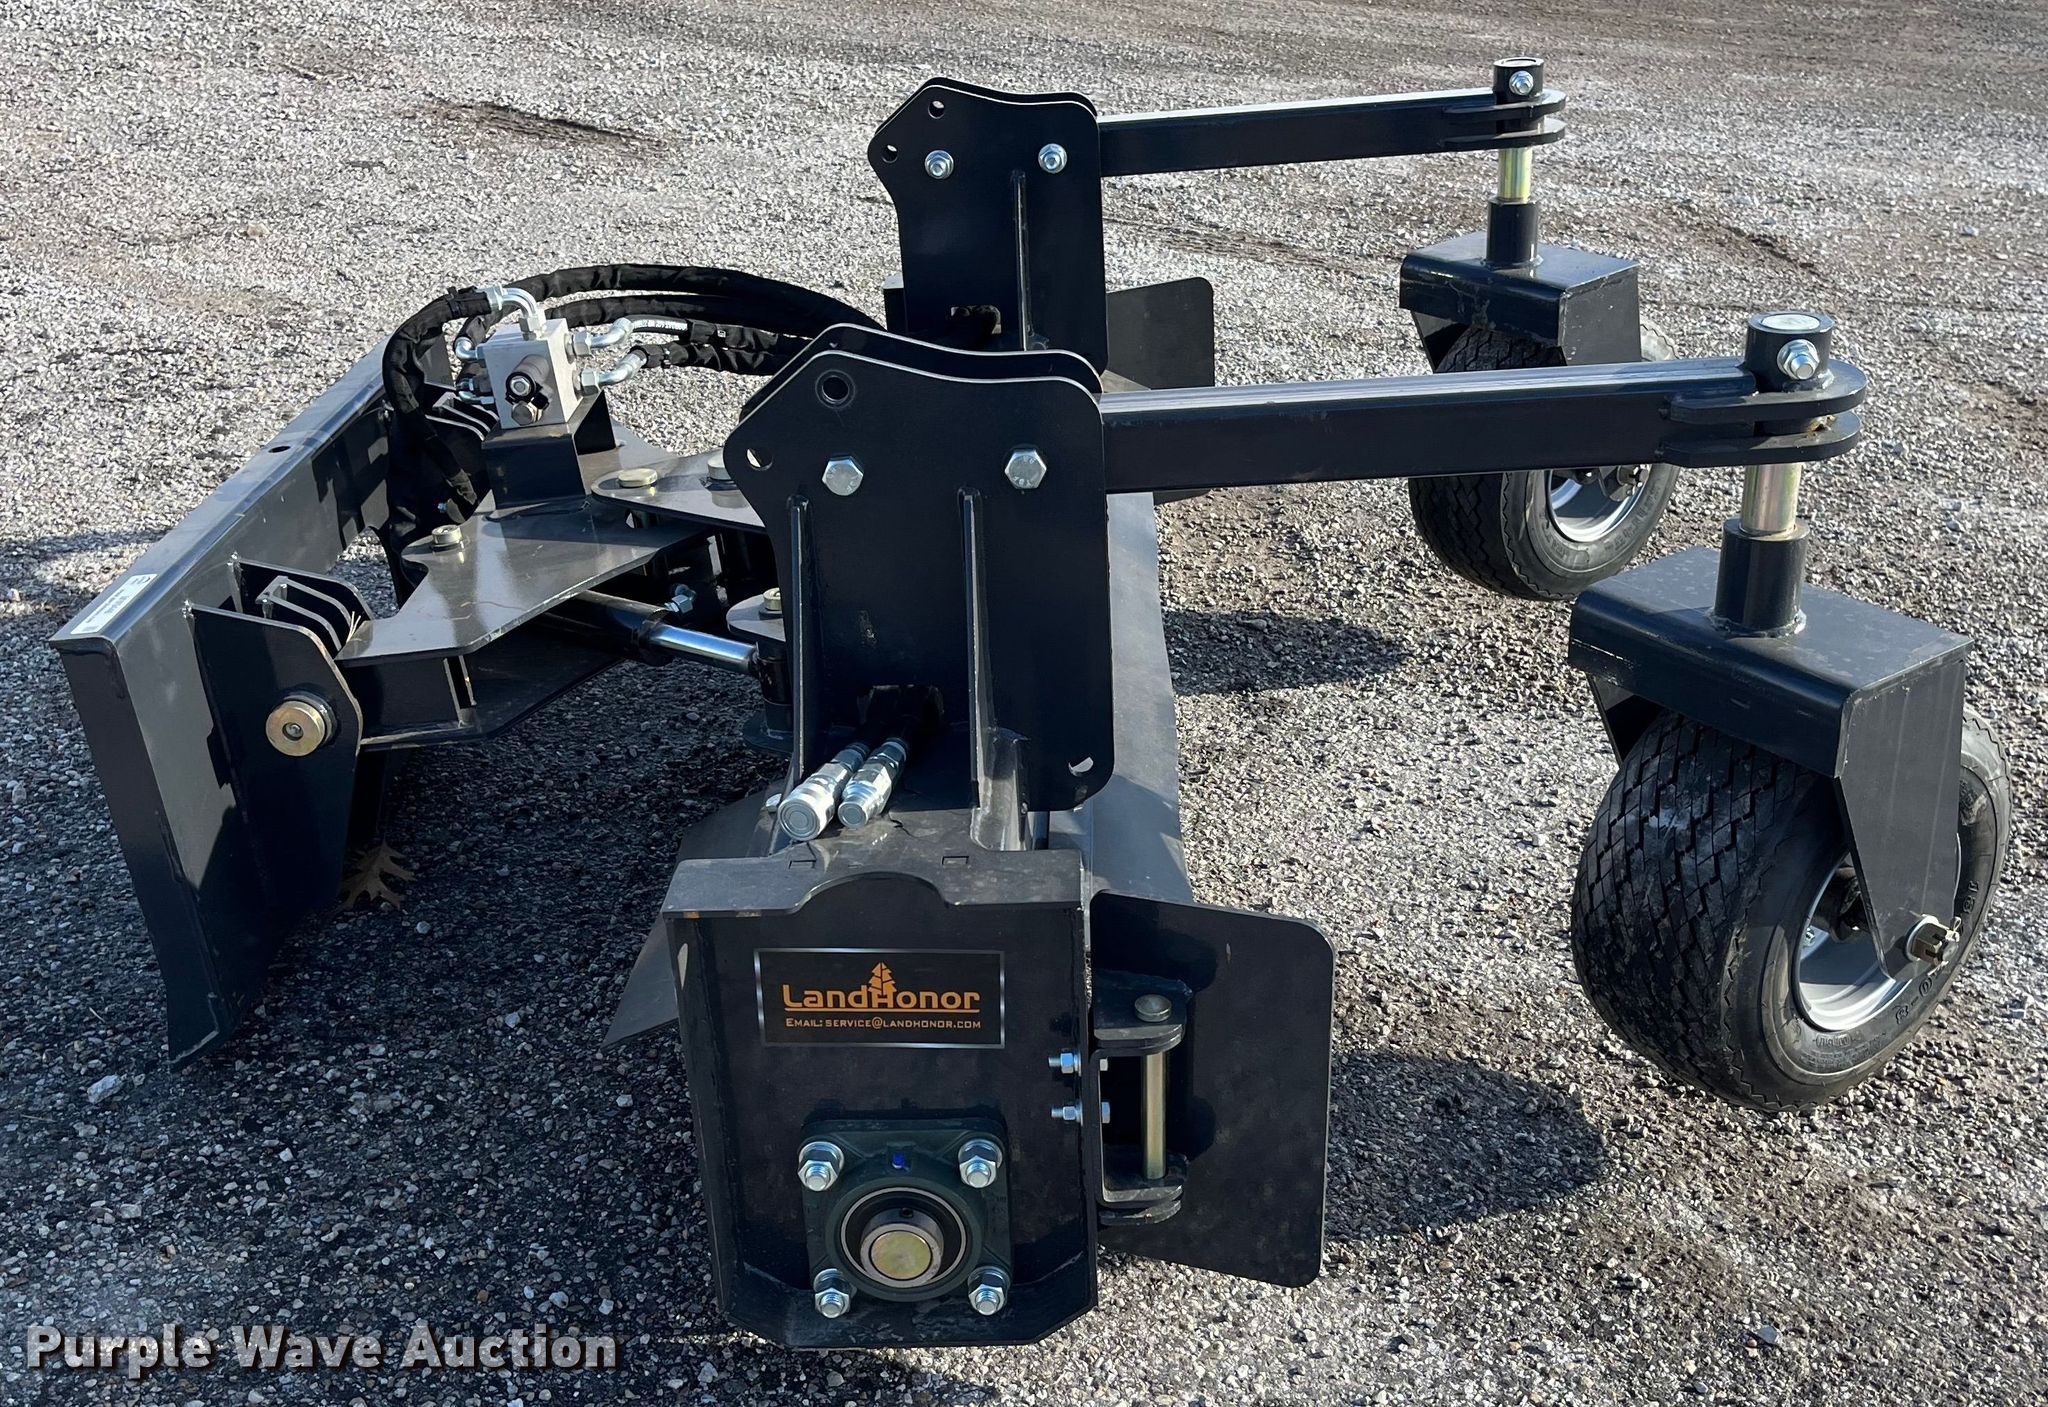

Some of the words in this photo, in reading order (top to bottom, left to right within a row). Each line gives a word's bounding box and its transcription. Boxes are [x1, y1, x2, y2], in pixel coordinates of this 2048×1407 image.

[782, 984, 981, 1009] LandHonor
[785, 1017, 823, 1028] EMAIL:
[825, 1016, 982, 1030] SERVICE@LANDHONOR.COM
